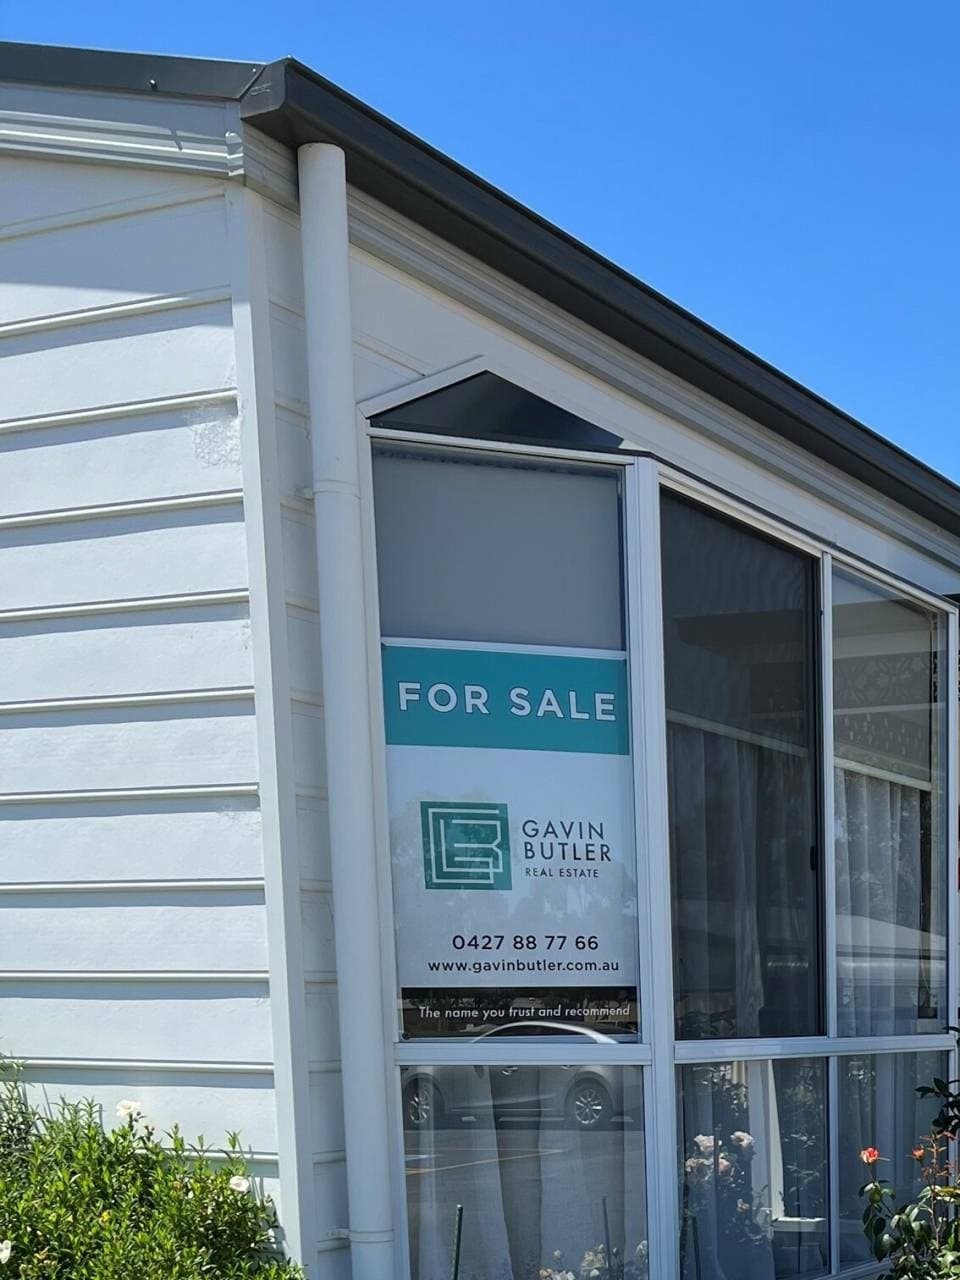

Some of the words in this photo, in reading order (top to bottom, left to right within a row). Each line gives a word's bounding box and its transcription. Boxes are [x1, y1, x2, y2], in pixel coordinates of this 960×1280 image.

[398, 681, 490, 715] FOR
[508, 686, 617, 722] SALE
[521, 819, 604, 840] GAVIN
[523, 841, 612, 862] BUTLER
[525, 867, 554, 877] REAL
[559, 868, 600, 879] ESTATE
[452, 934, 505, 950] 0427
[513, 935, 538, 950] 88
[544, 935, 568, 950] 77
[575, 935, 599, 950] 66
[427, 959, 620, 973] www.gavinbutler.com.au
[419, 1006, 441, 1018] The
[445, 1009, 479, 1018] name
[482, 1009, 505, 1021] you
[509, 1006, 535, 1017] trust
[538, 1004, 562, 1017] and
[565, 1003, 631, 1017] recommend
